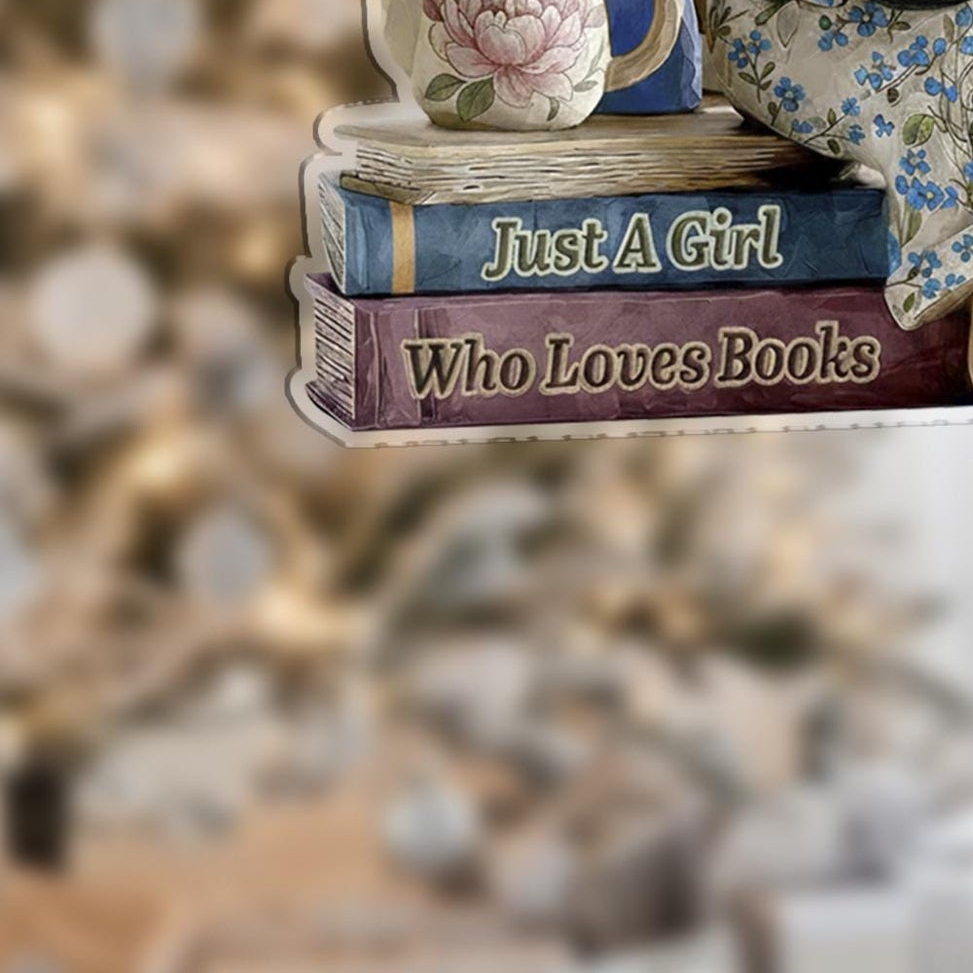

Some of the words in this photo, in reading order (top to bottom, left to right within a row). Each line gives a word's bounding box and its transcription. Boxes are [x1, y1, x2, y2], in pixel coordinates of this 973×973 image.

[482, 217, 606, 280] Just
[614, 214, 663, 273] A
[671, 207, 782, 270] Girl
[402, 335, 534, 398] Who
[541, 332, 709, 394] Loves
[718, 322, 881, 387] Books
